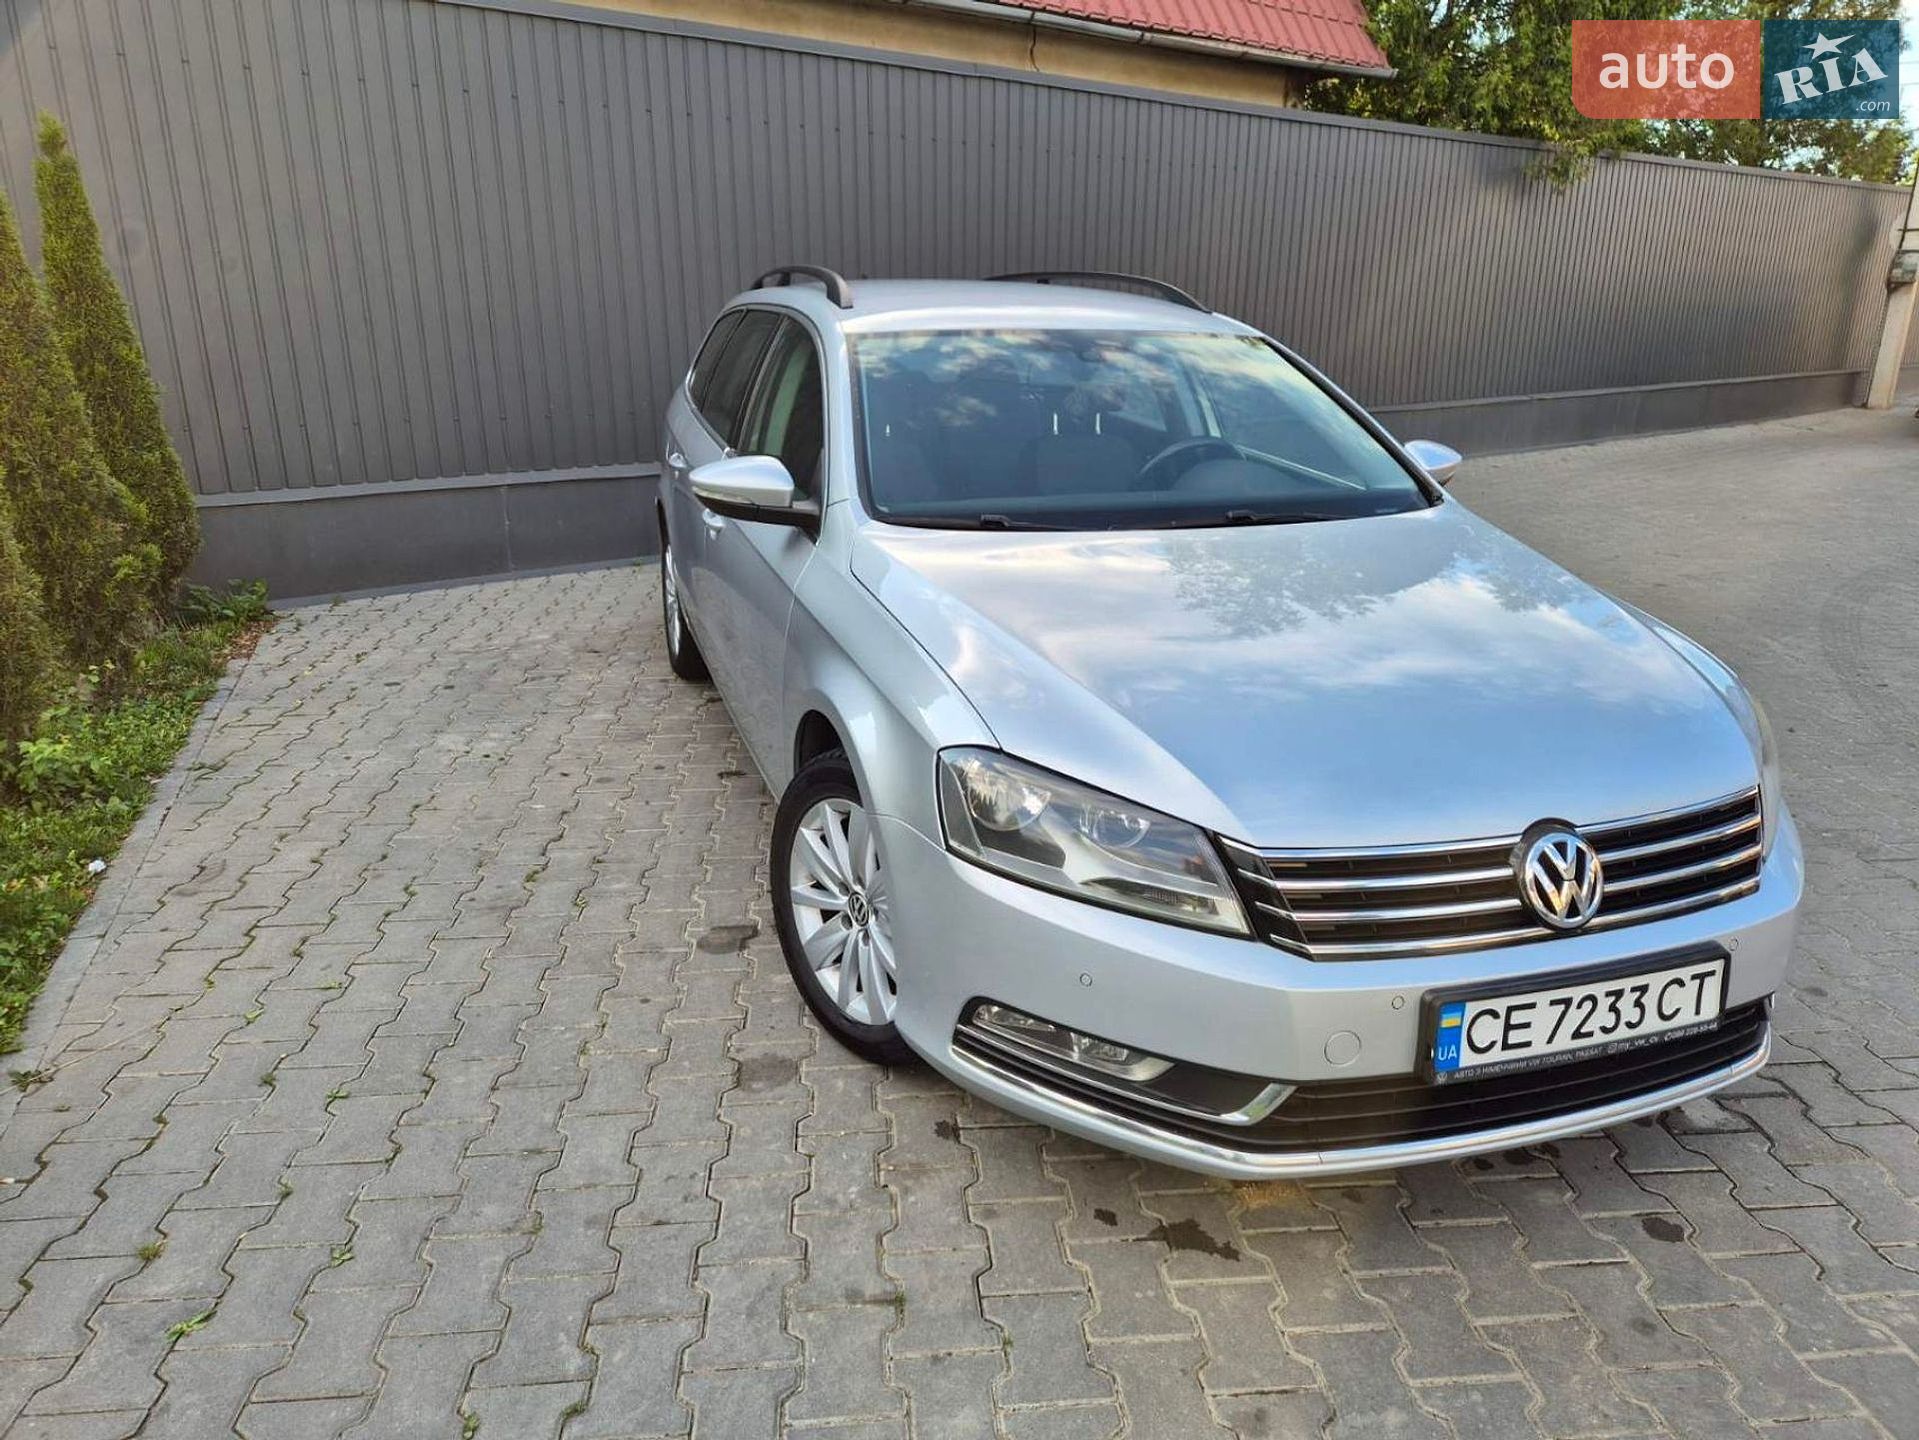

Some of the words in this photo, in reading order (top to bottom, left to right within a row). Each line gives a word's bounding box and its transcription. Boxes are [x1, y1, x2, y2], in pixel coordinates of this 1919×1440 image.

[1528, 834, 1600, 926] VW
[1437, 1045, 1458, 1061] UA
[1466, 1001, 1537, 1054] CE
[1546, 983, 1650, 1045] 7233
[1656, 969, 1717, 1022] CT
